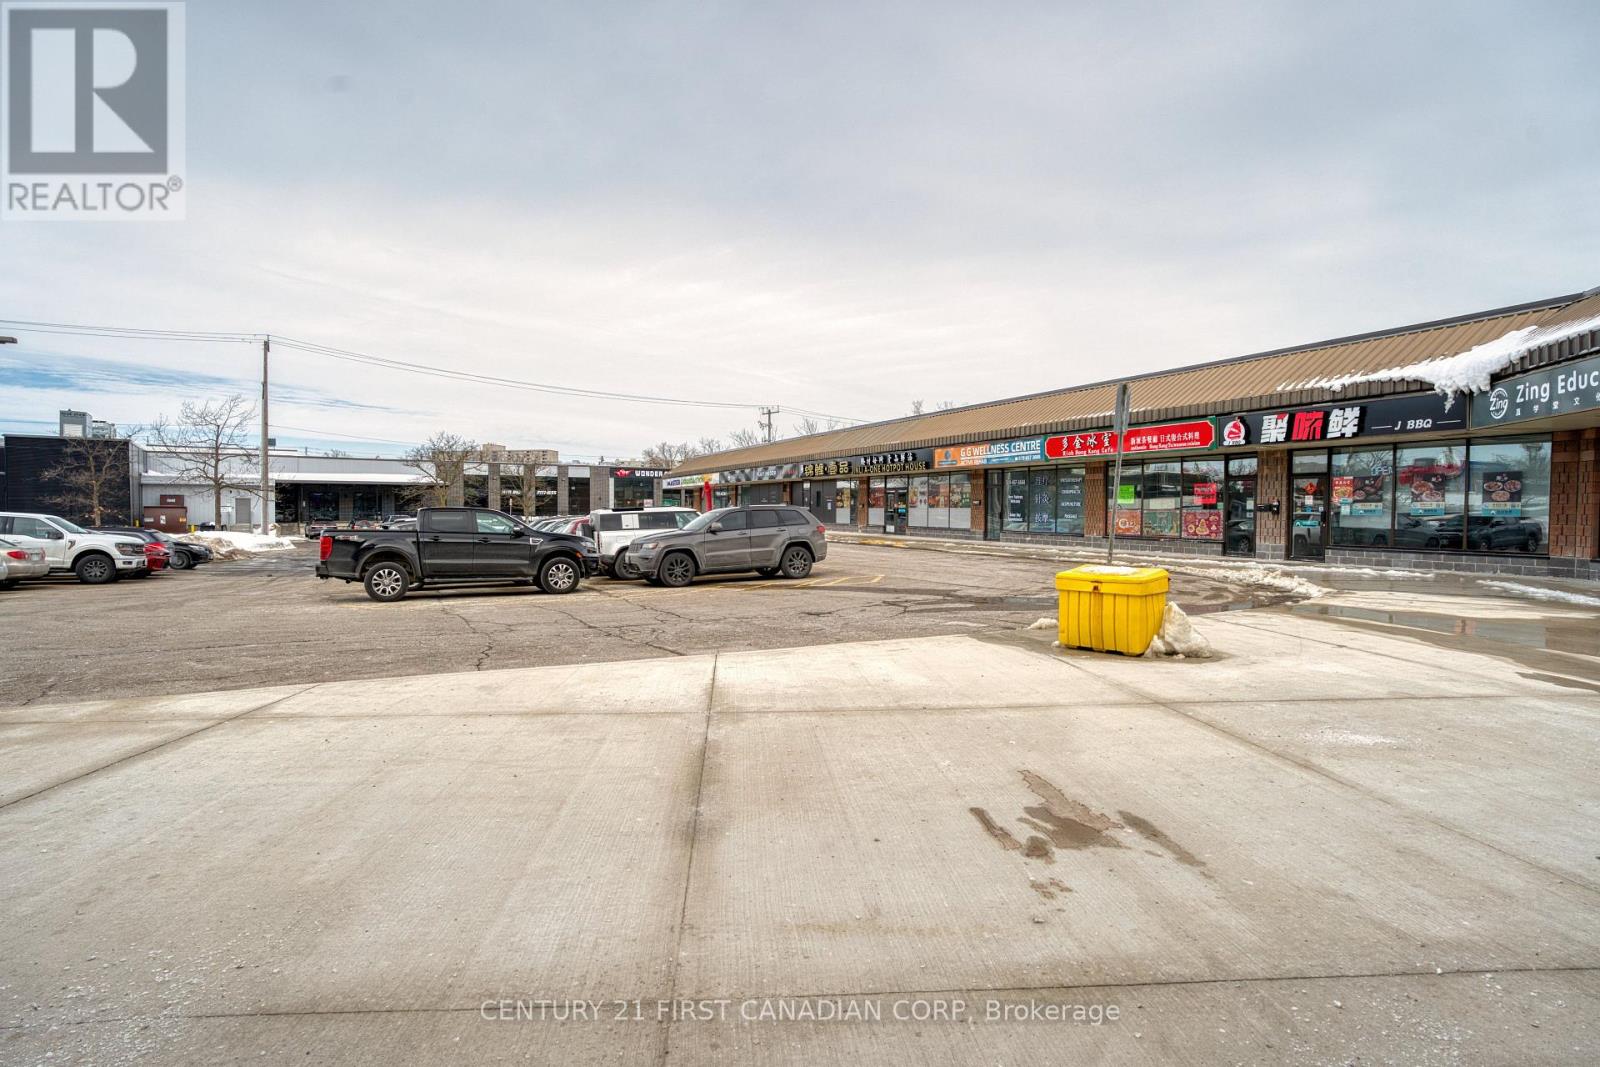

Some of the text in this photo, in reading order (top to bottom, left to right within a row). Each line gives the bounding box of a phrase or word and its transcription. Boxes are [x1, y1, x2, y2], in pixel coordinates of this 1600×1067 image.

[1515, 370, 1600, 403] Zing Educ
[1394, 418, 1433, 431] J BBQ
[972, 443, 1009, 456] WELLNESS
[1012, 440, 1041, 452] CENTRE
[882, 462, 904, 472] HOTPOT
[906, 460, 926, 470] HOUSE
[634, 470, 663, 478] WONDER
